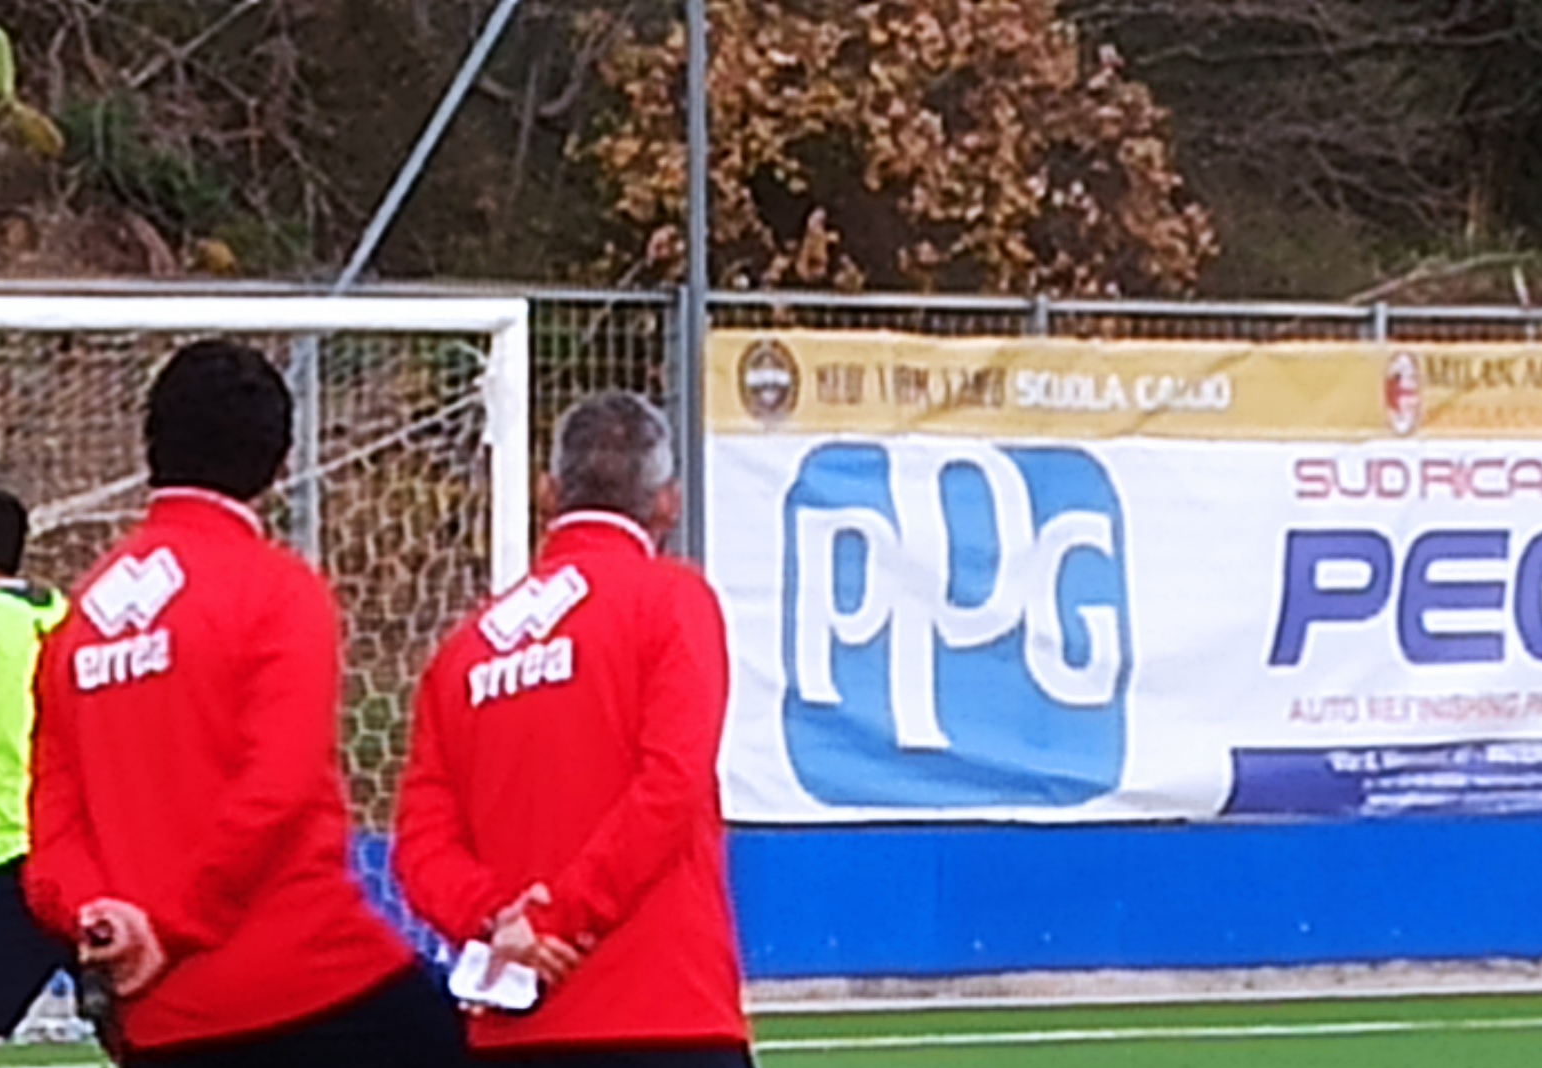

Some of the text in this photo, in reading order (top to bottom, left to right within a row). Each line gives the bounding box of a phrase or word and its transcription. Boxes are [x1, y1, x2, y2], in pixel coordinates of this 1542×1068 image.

[1293, 459, 1410, 498] SUD
[795, 436, 1123, 750] PPG
[1289, 694, 1358, 724] AUTO
